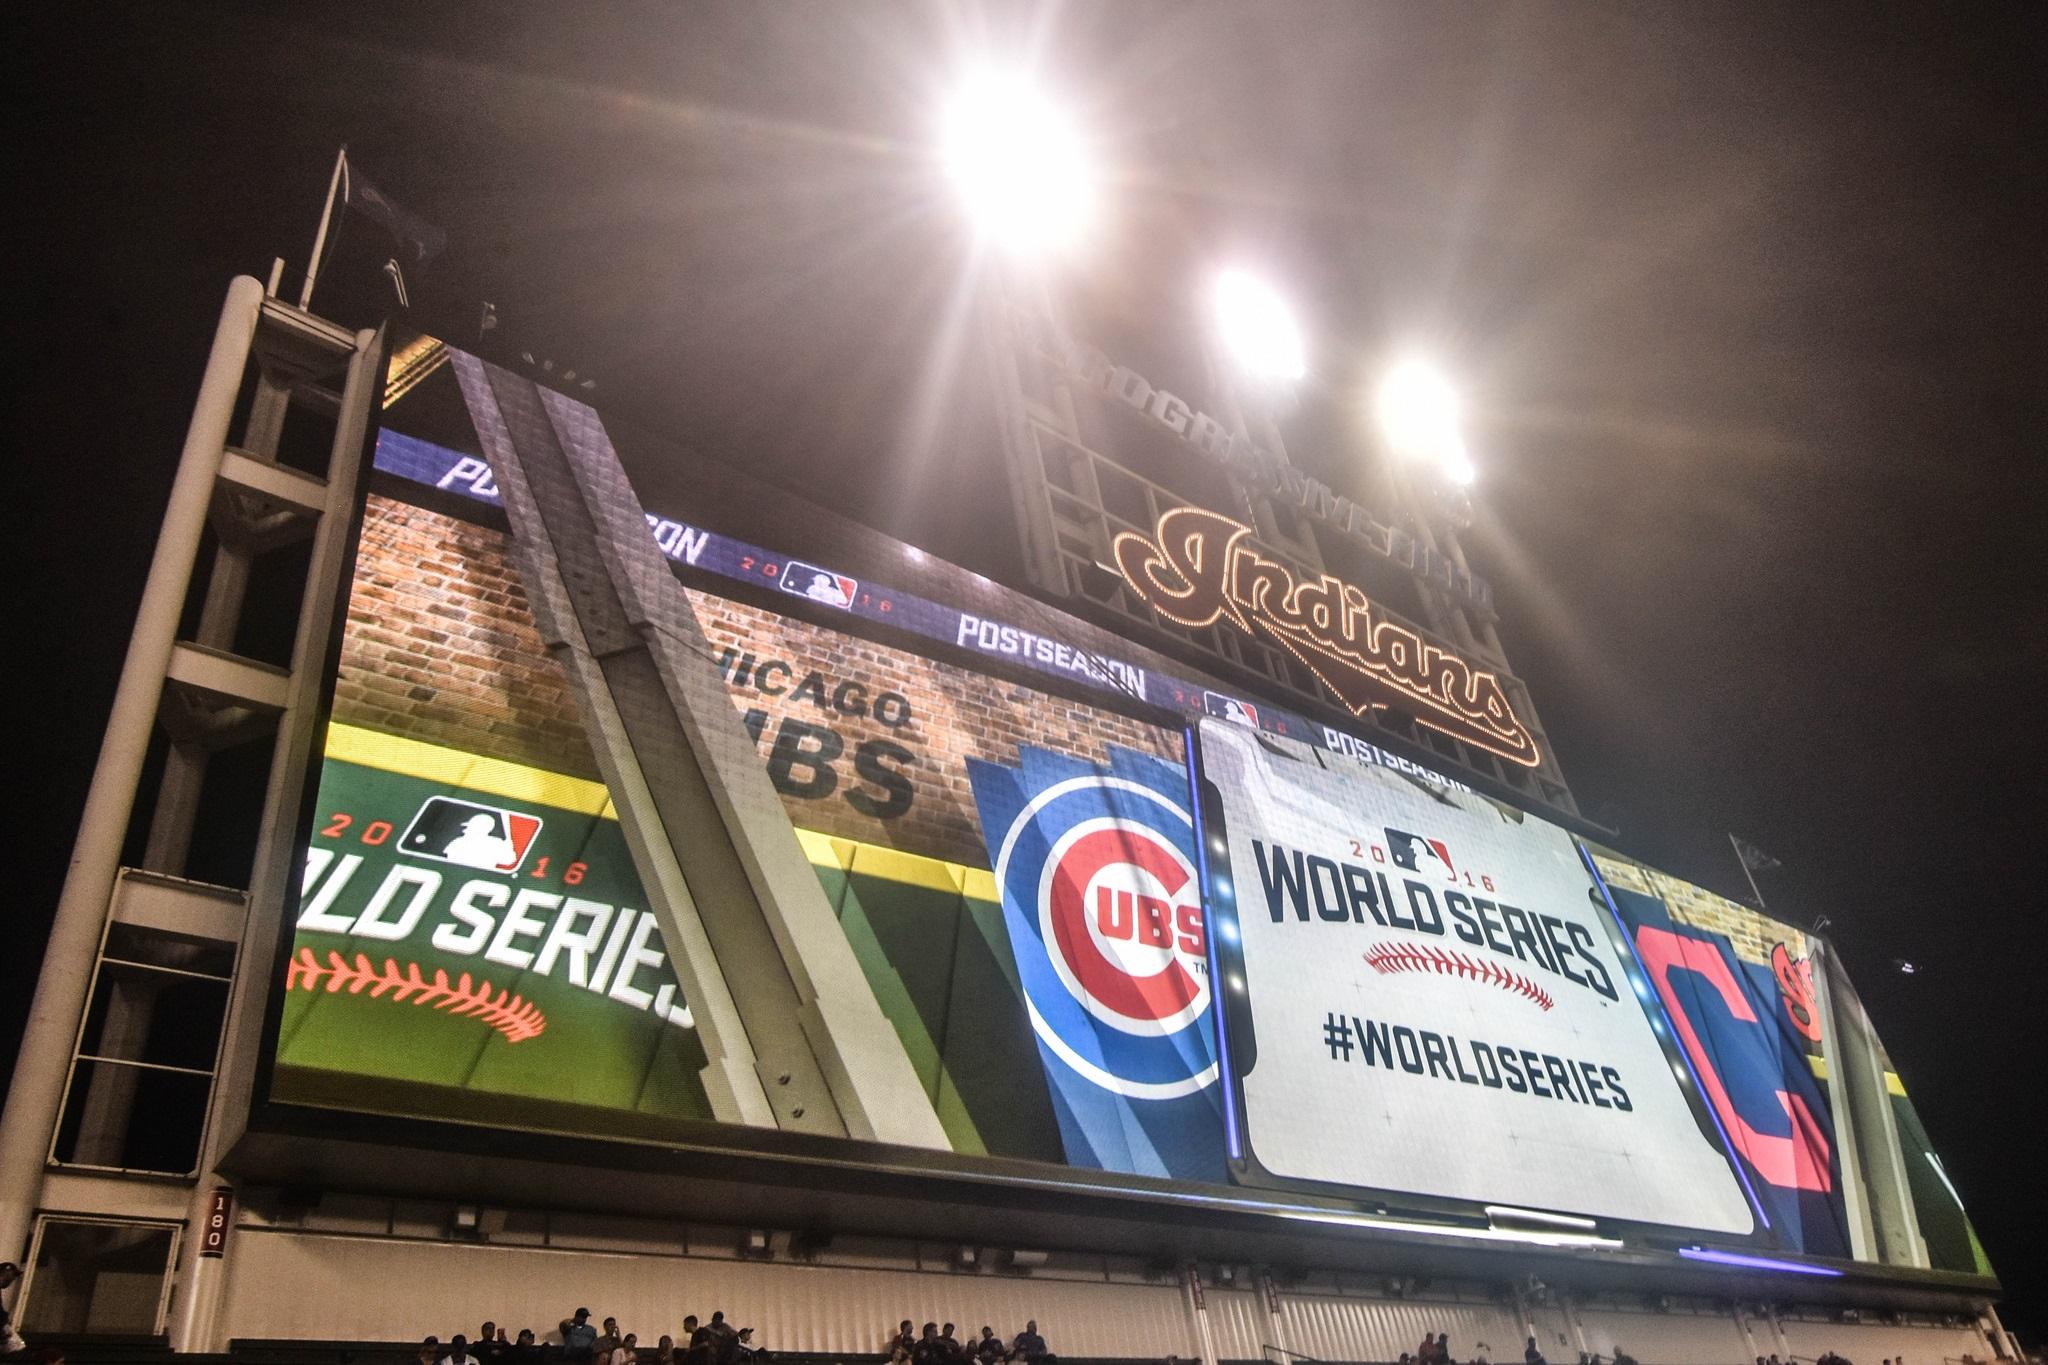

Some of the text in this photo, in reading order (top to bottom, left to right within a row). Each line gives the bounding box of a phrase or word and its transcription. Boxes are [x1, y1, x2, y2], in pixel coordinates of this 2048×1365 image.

[957, 613, 1146, 701] POSTSEASON
[1113, 506, 1530, 742] Indians
[321, 813, 588, 886] 20 16
[1350, 840, 1495, 893] 20 16
[1252, 839, 1620, 1002] WORLD SERIES
[1323, 1012, 1633, 1113] #WORLDSERIES
[208, 1197, 224, 1246] 180
